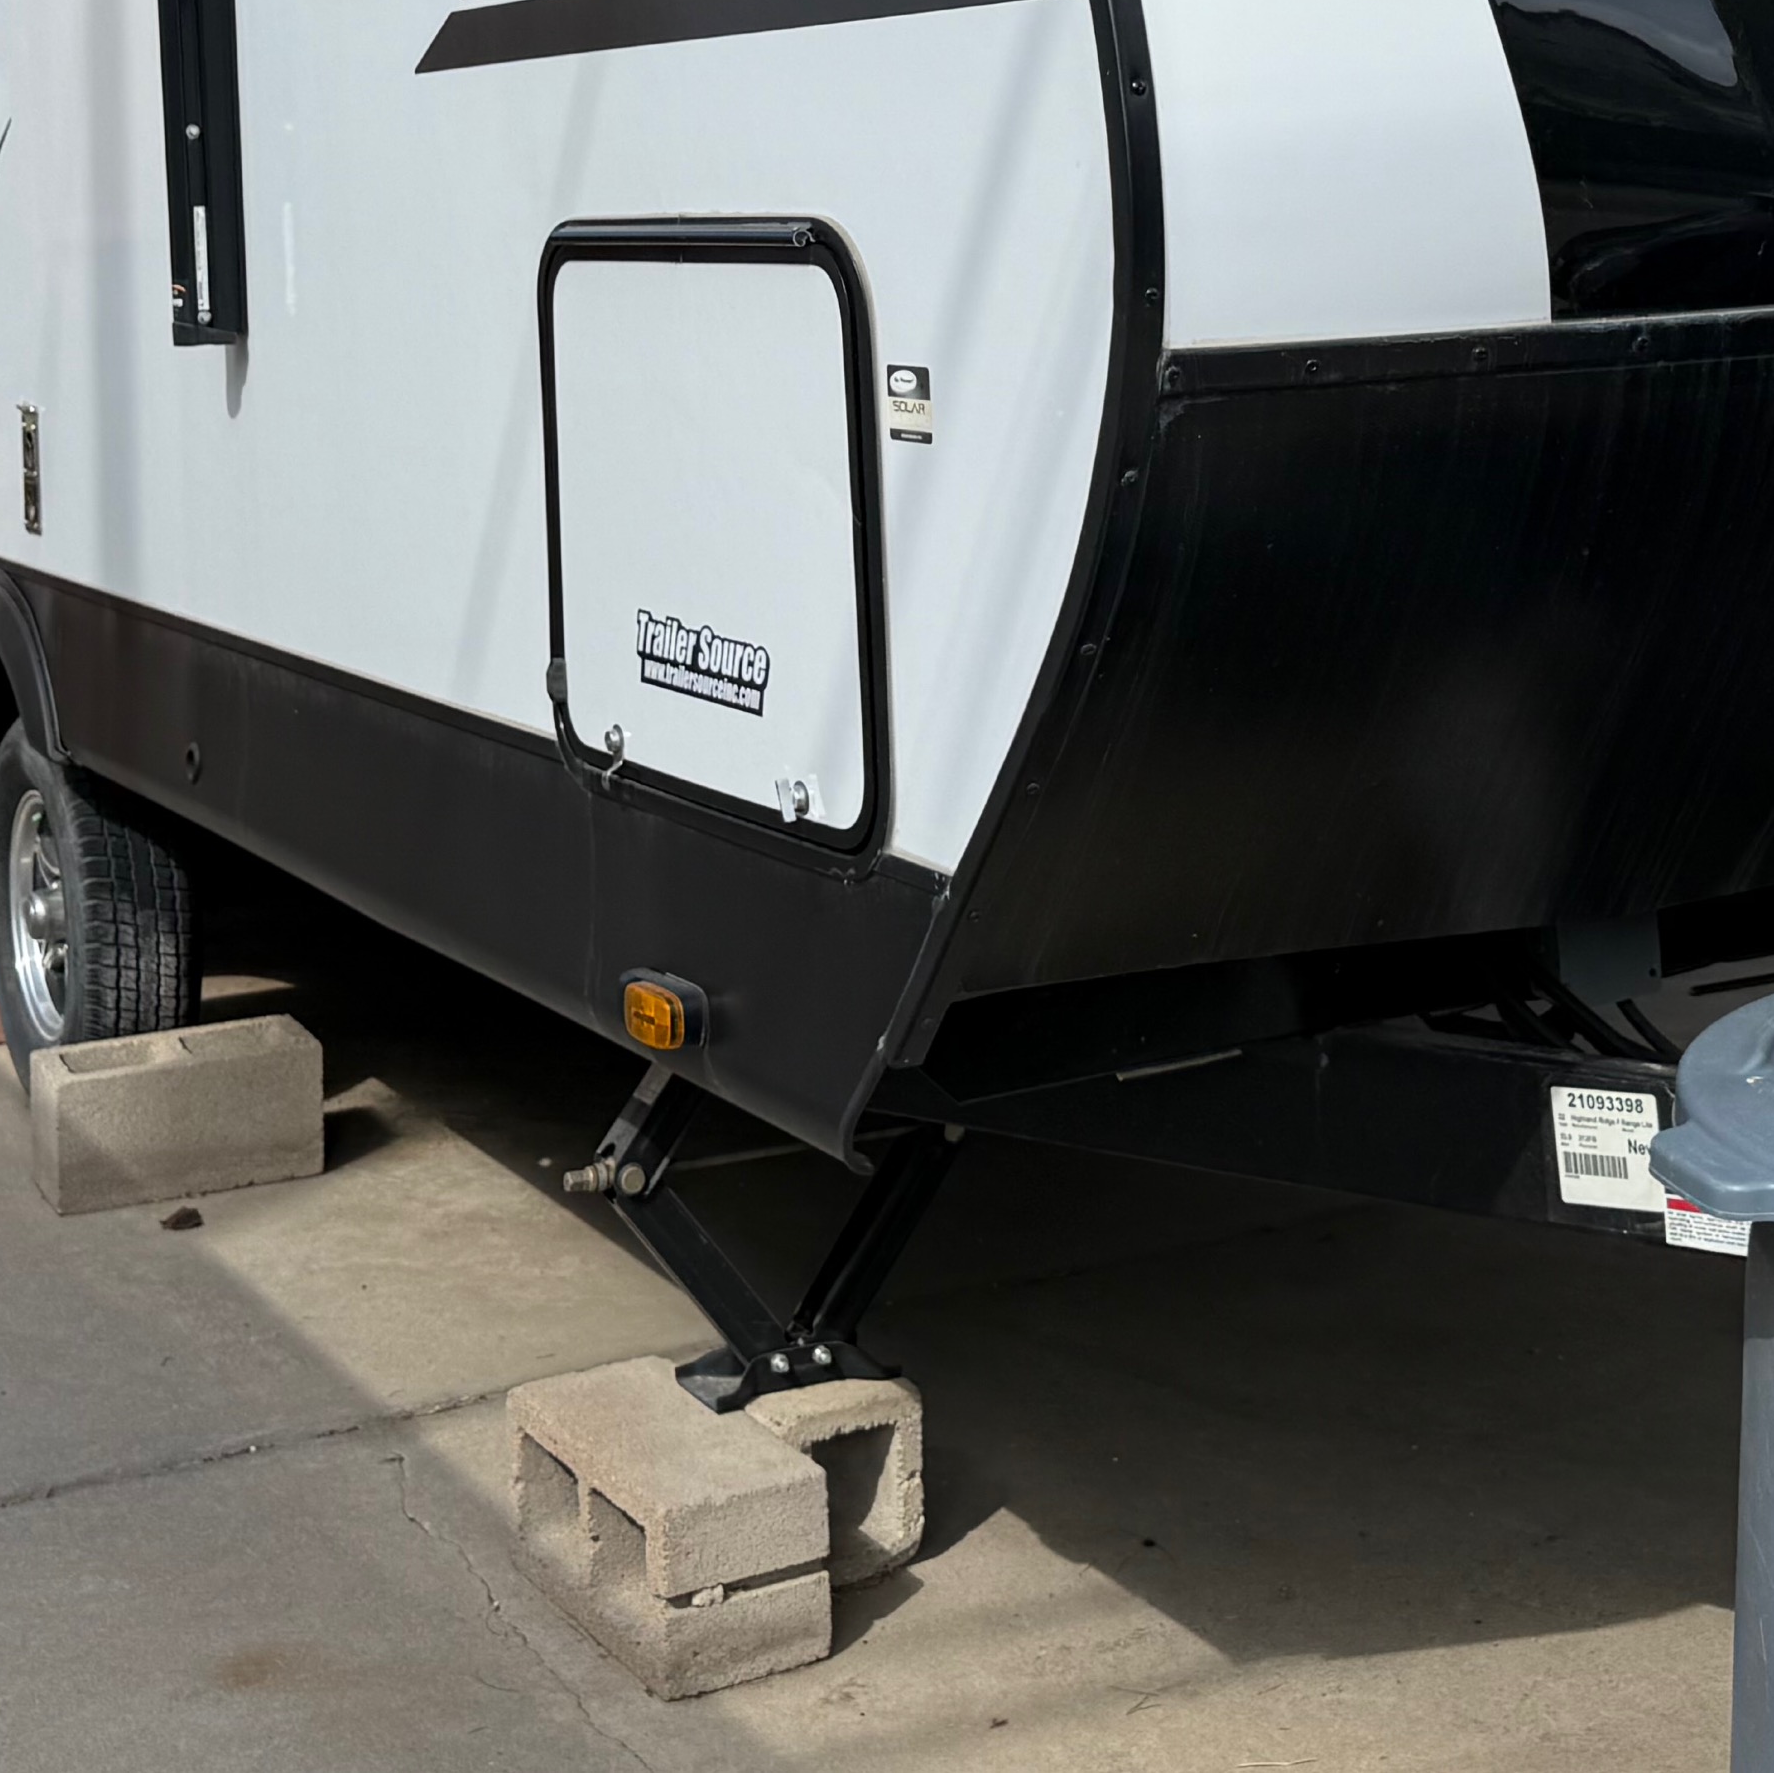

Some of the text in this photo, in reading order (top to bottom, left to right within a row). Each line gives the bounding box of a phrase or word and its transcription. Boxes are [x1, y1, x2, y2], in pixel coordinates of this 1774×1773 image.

[892, 400, 926, 415] SOLAR
[637, 610, 768, 685] Trailer Source
[643, 657, 761, 710] www.trailersourceinc.com
[1567, 1092, 1644, 1114] 21093398
